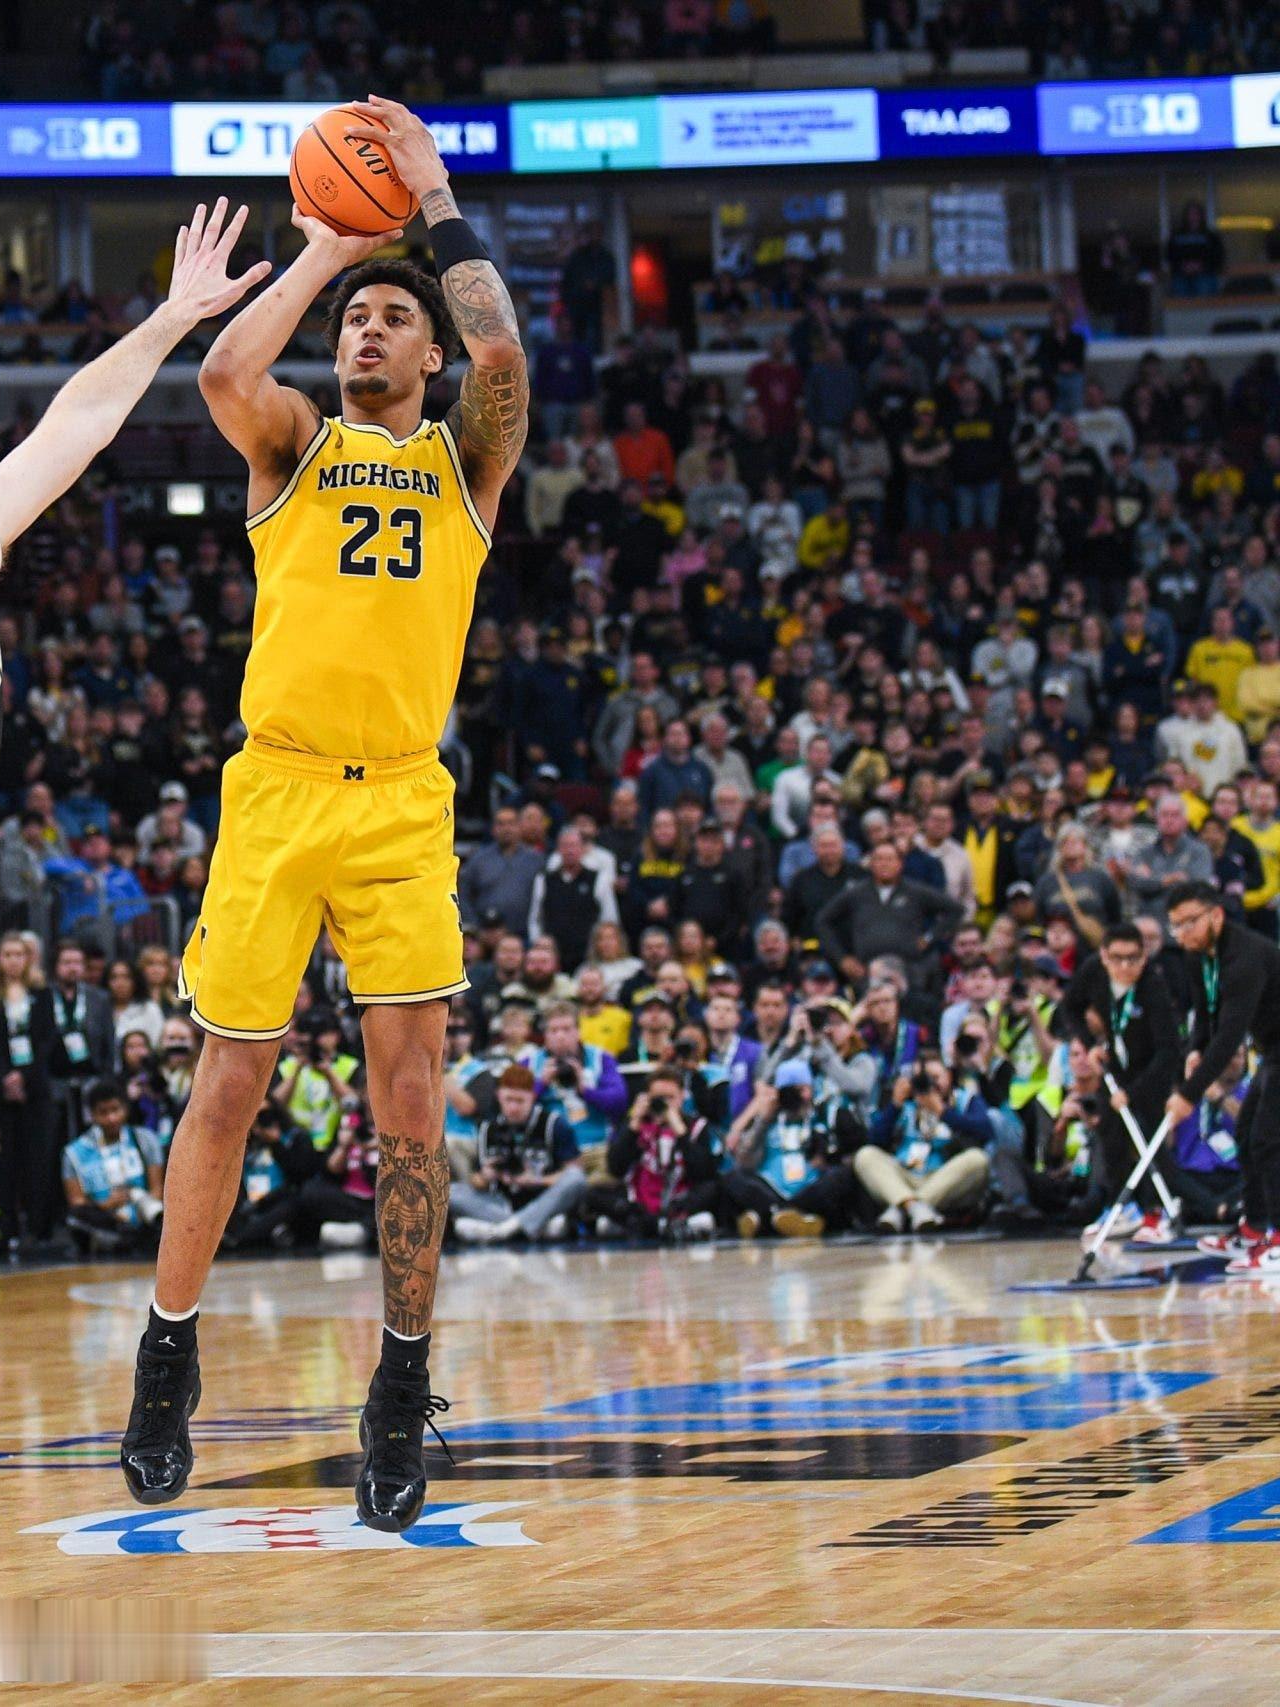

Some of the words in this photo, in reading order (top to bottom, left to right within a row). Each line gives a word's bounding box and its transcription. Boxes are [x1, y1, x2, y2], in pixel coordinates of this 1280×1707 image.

[254, 121, 292, 157] TI
[426, 121, 463, 155] CK
[465, 122, 498, 155] IN
[531, 119, 578, 152] THE
[581, 117, 639, 149] WIN
[317, 462, 441, 499] MICHGAN
[337, 503, 422, 582] 23
[342, 764, 366, 781] M
[378, 1152, 429, 1172] ERIOUS?
[817, 1489, 1136, 1548] MEN'S
